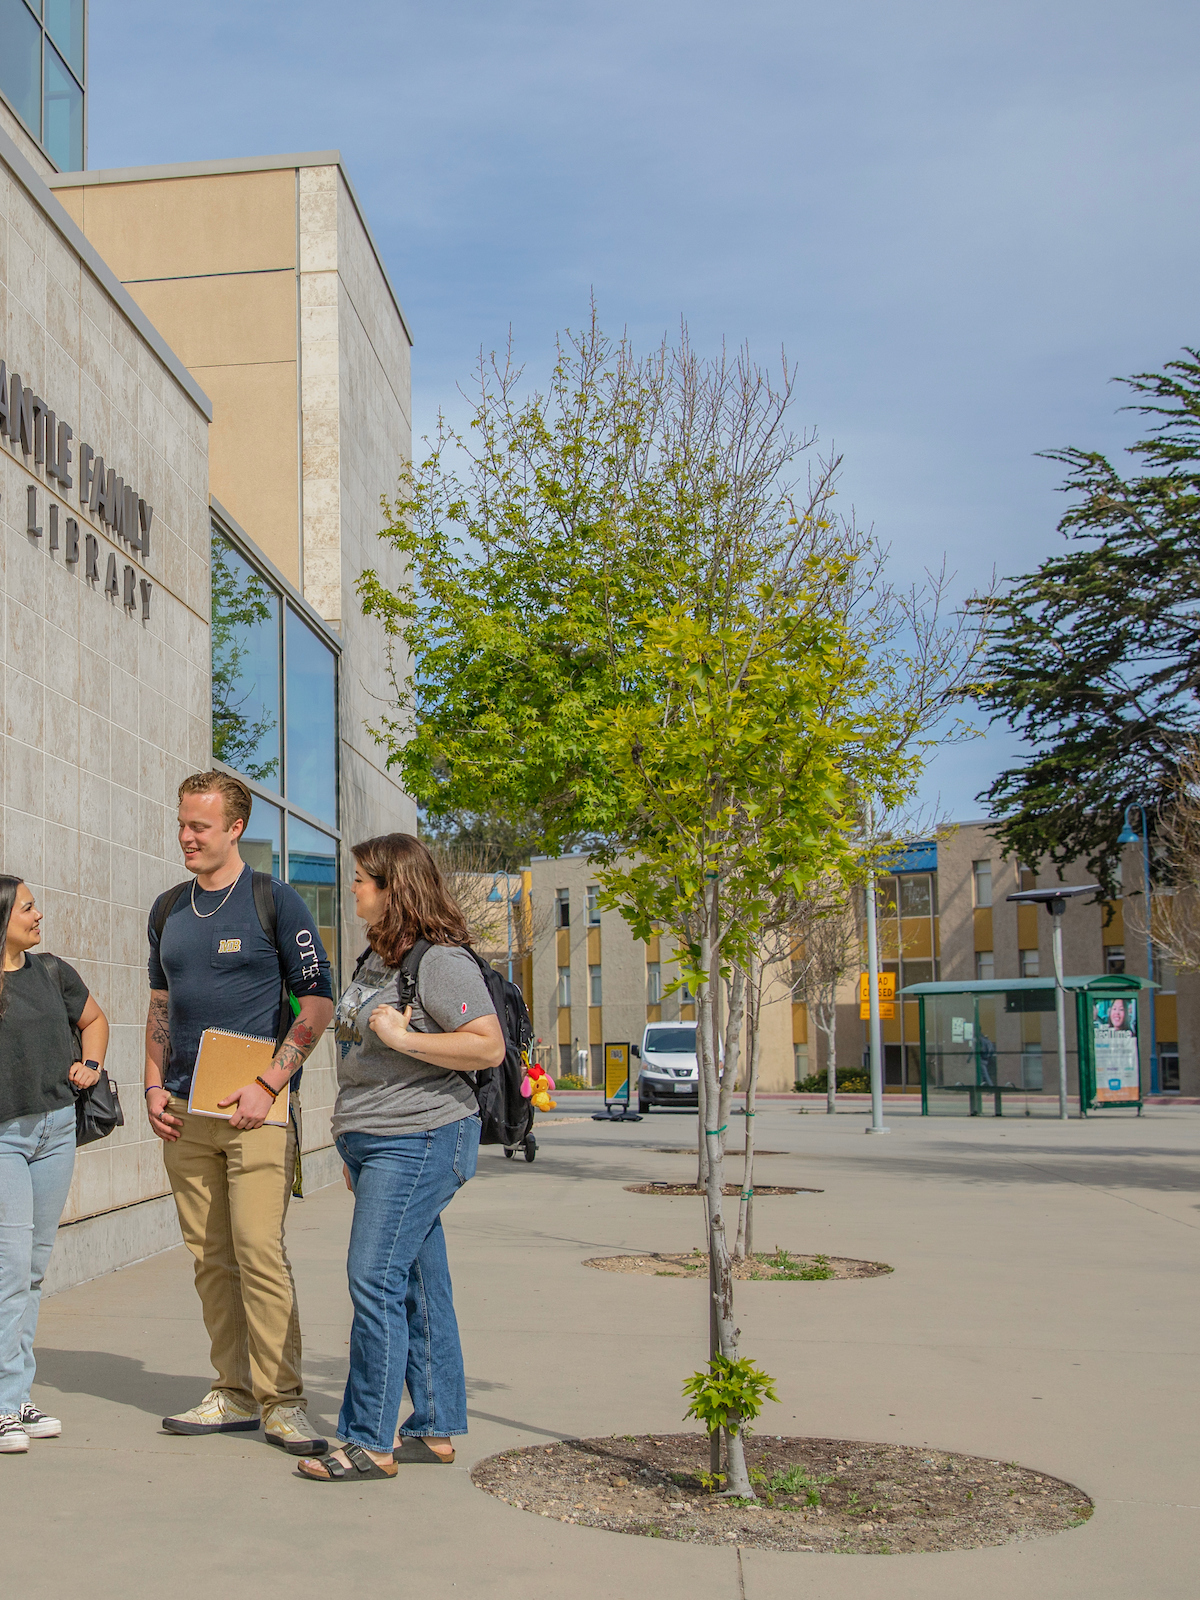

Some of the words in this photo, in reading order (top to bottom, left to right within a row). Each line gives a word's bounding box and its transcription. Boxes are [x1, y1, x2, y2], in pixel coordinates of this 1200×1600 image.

[27, 485, 153, 619] LIBRARY
[80, 442, 153, 557] FAMILY
[217, 938, 242, 954] MB
